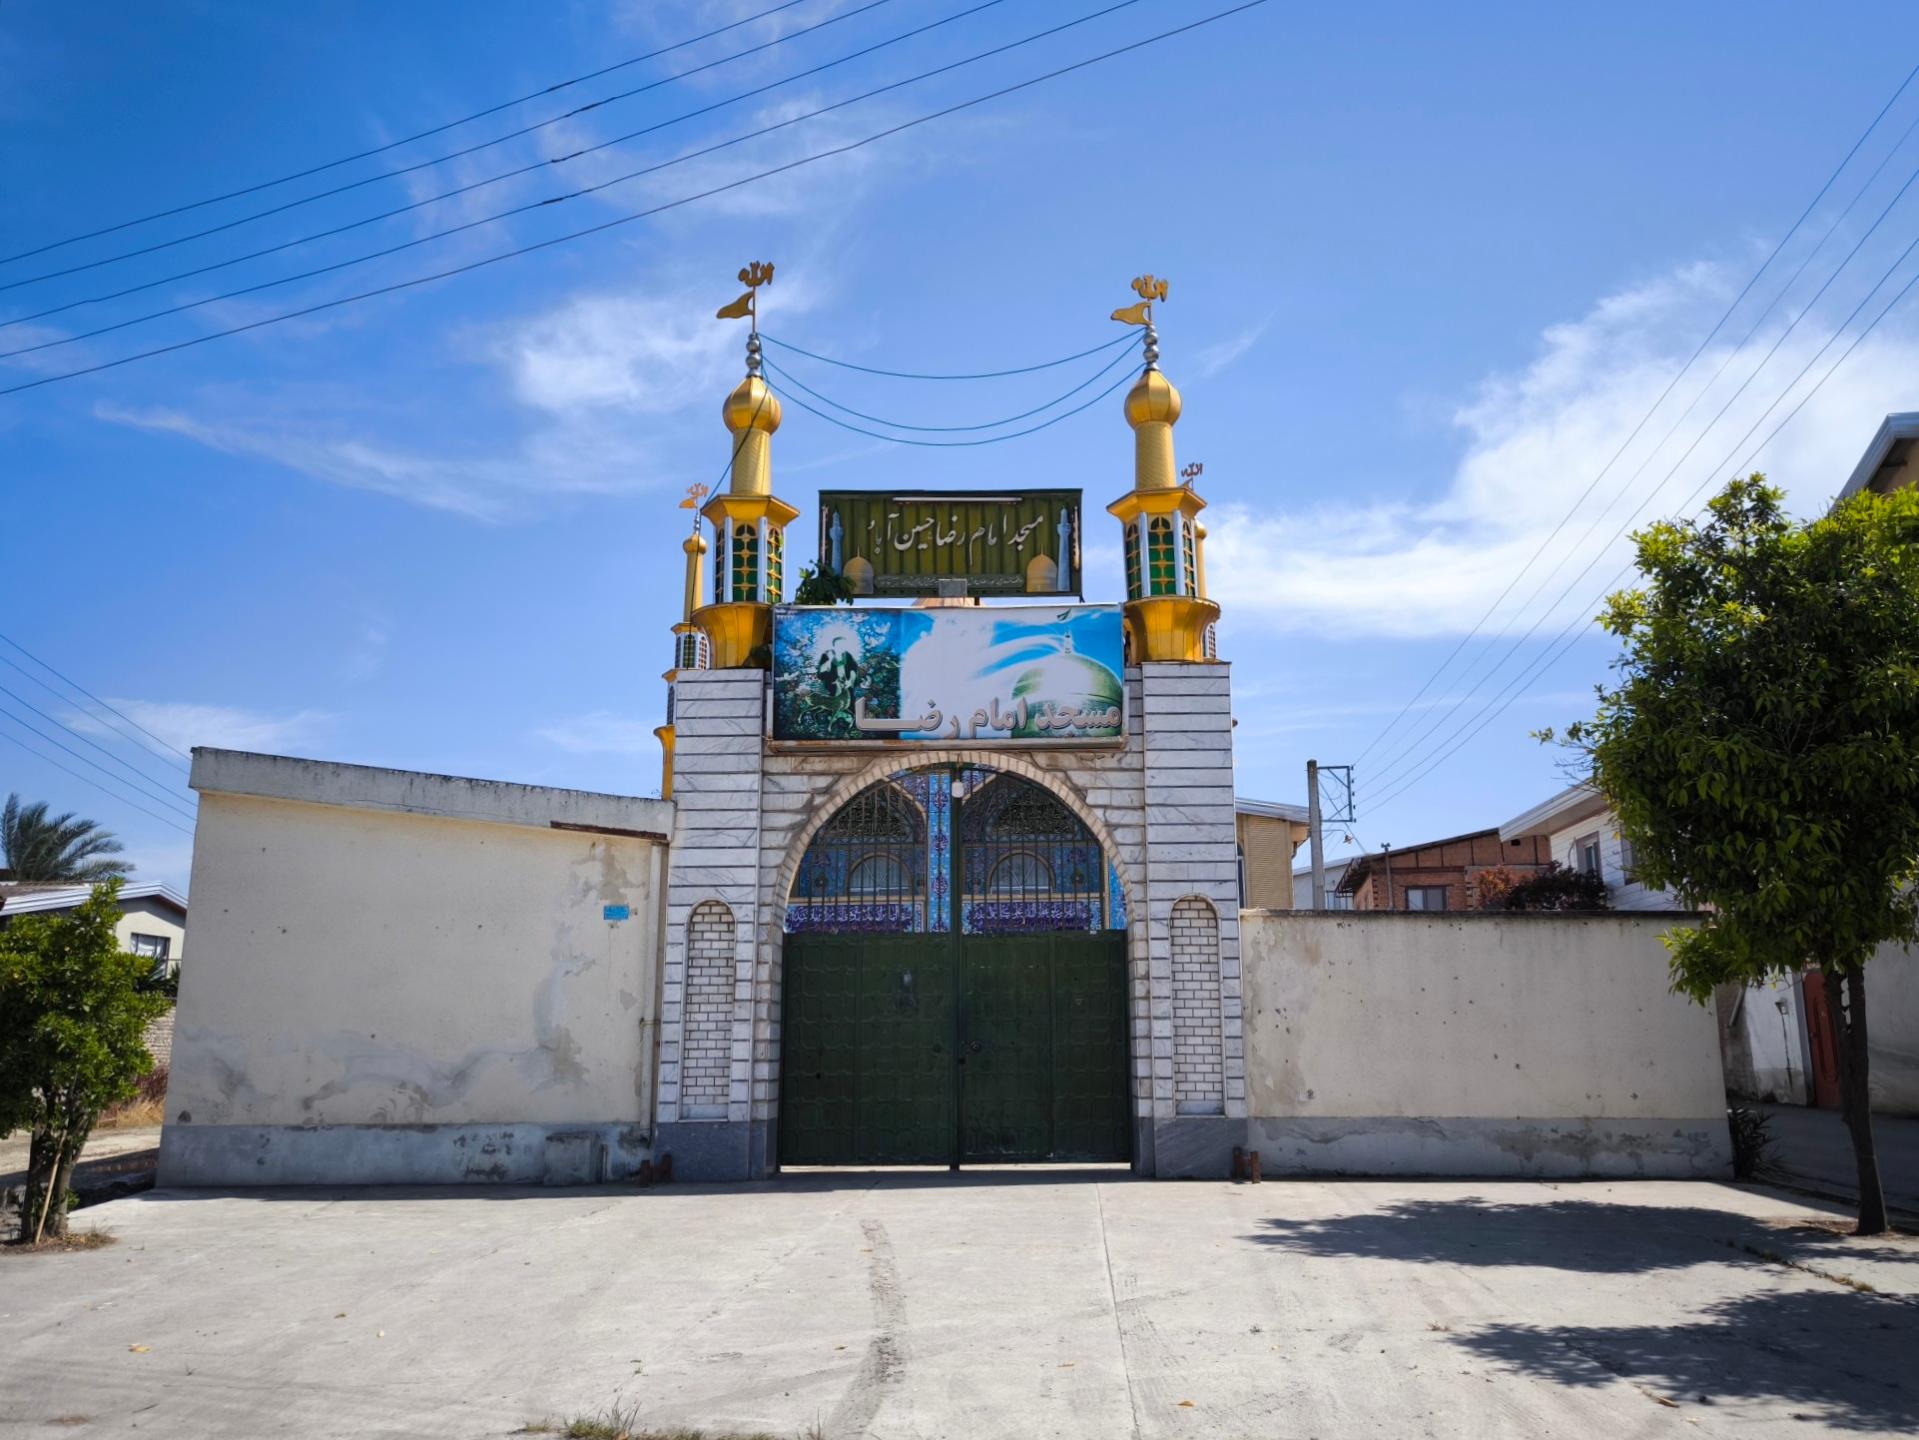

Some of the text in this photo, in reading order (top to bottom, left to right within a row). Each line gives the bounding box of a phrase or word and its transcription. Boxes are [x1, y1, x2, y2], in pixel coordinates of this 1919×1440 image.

[867, 512, 900, 554] آباد
[936, 515, 966, 546] رضا
[969, 513, 1007, 567] امام
[1007, 515, 1043, 551] مسجد
[855, 696, 1121, 739] مسجد امام رضا
